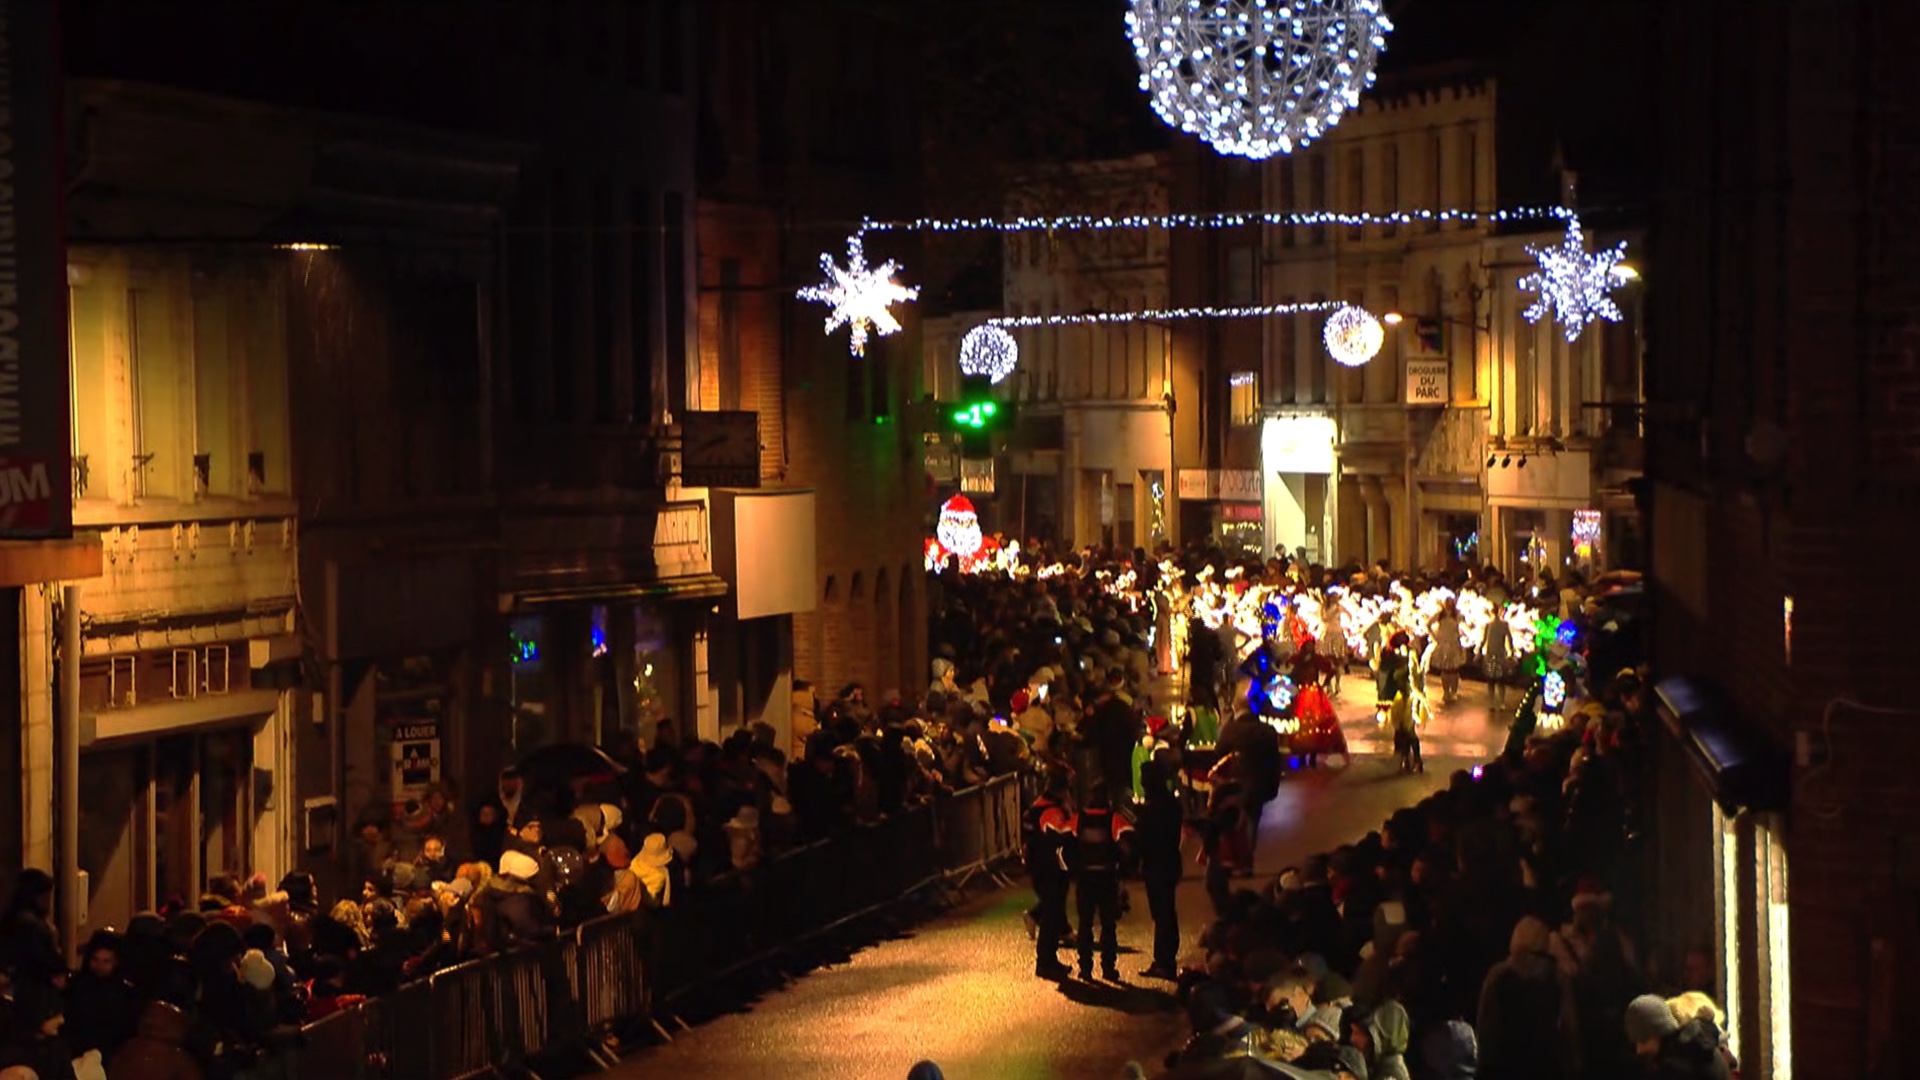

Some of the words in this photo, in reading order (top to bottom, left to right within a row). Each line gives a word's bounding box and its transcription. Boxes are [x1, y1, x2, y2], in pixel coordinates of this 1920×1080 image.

[1420, 376, 1435, 386] DU
[1415, 387, 1440, 399] PARC
[404, 725, 437, 739] LOUER
